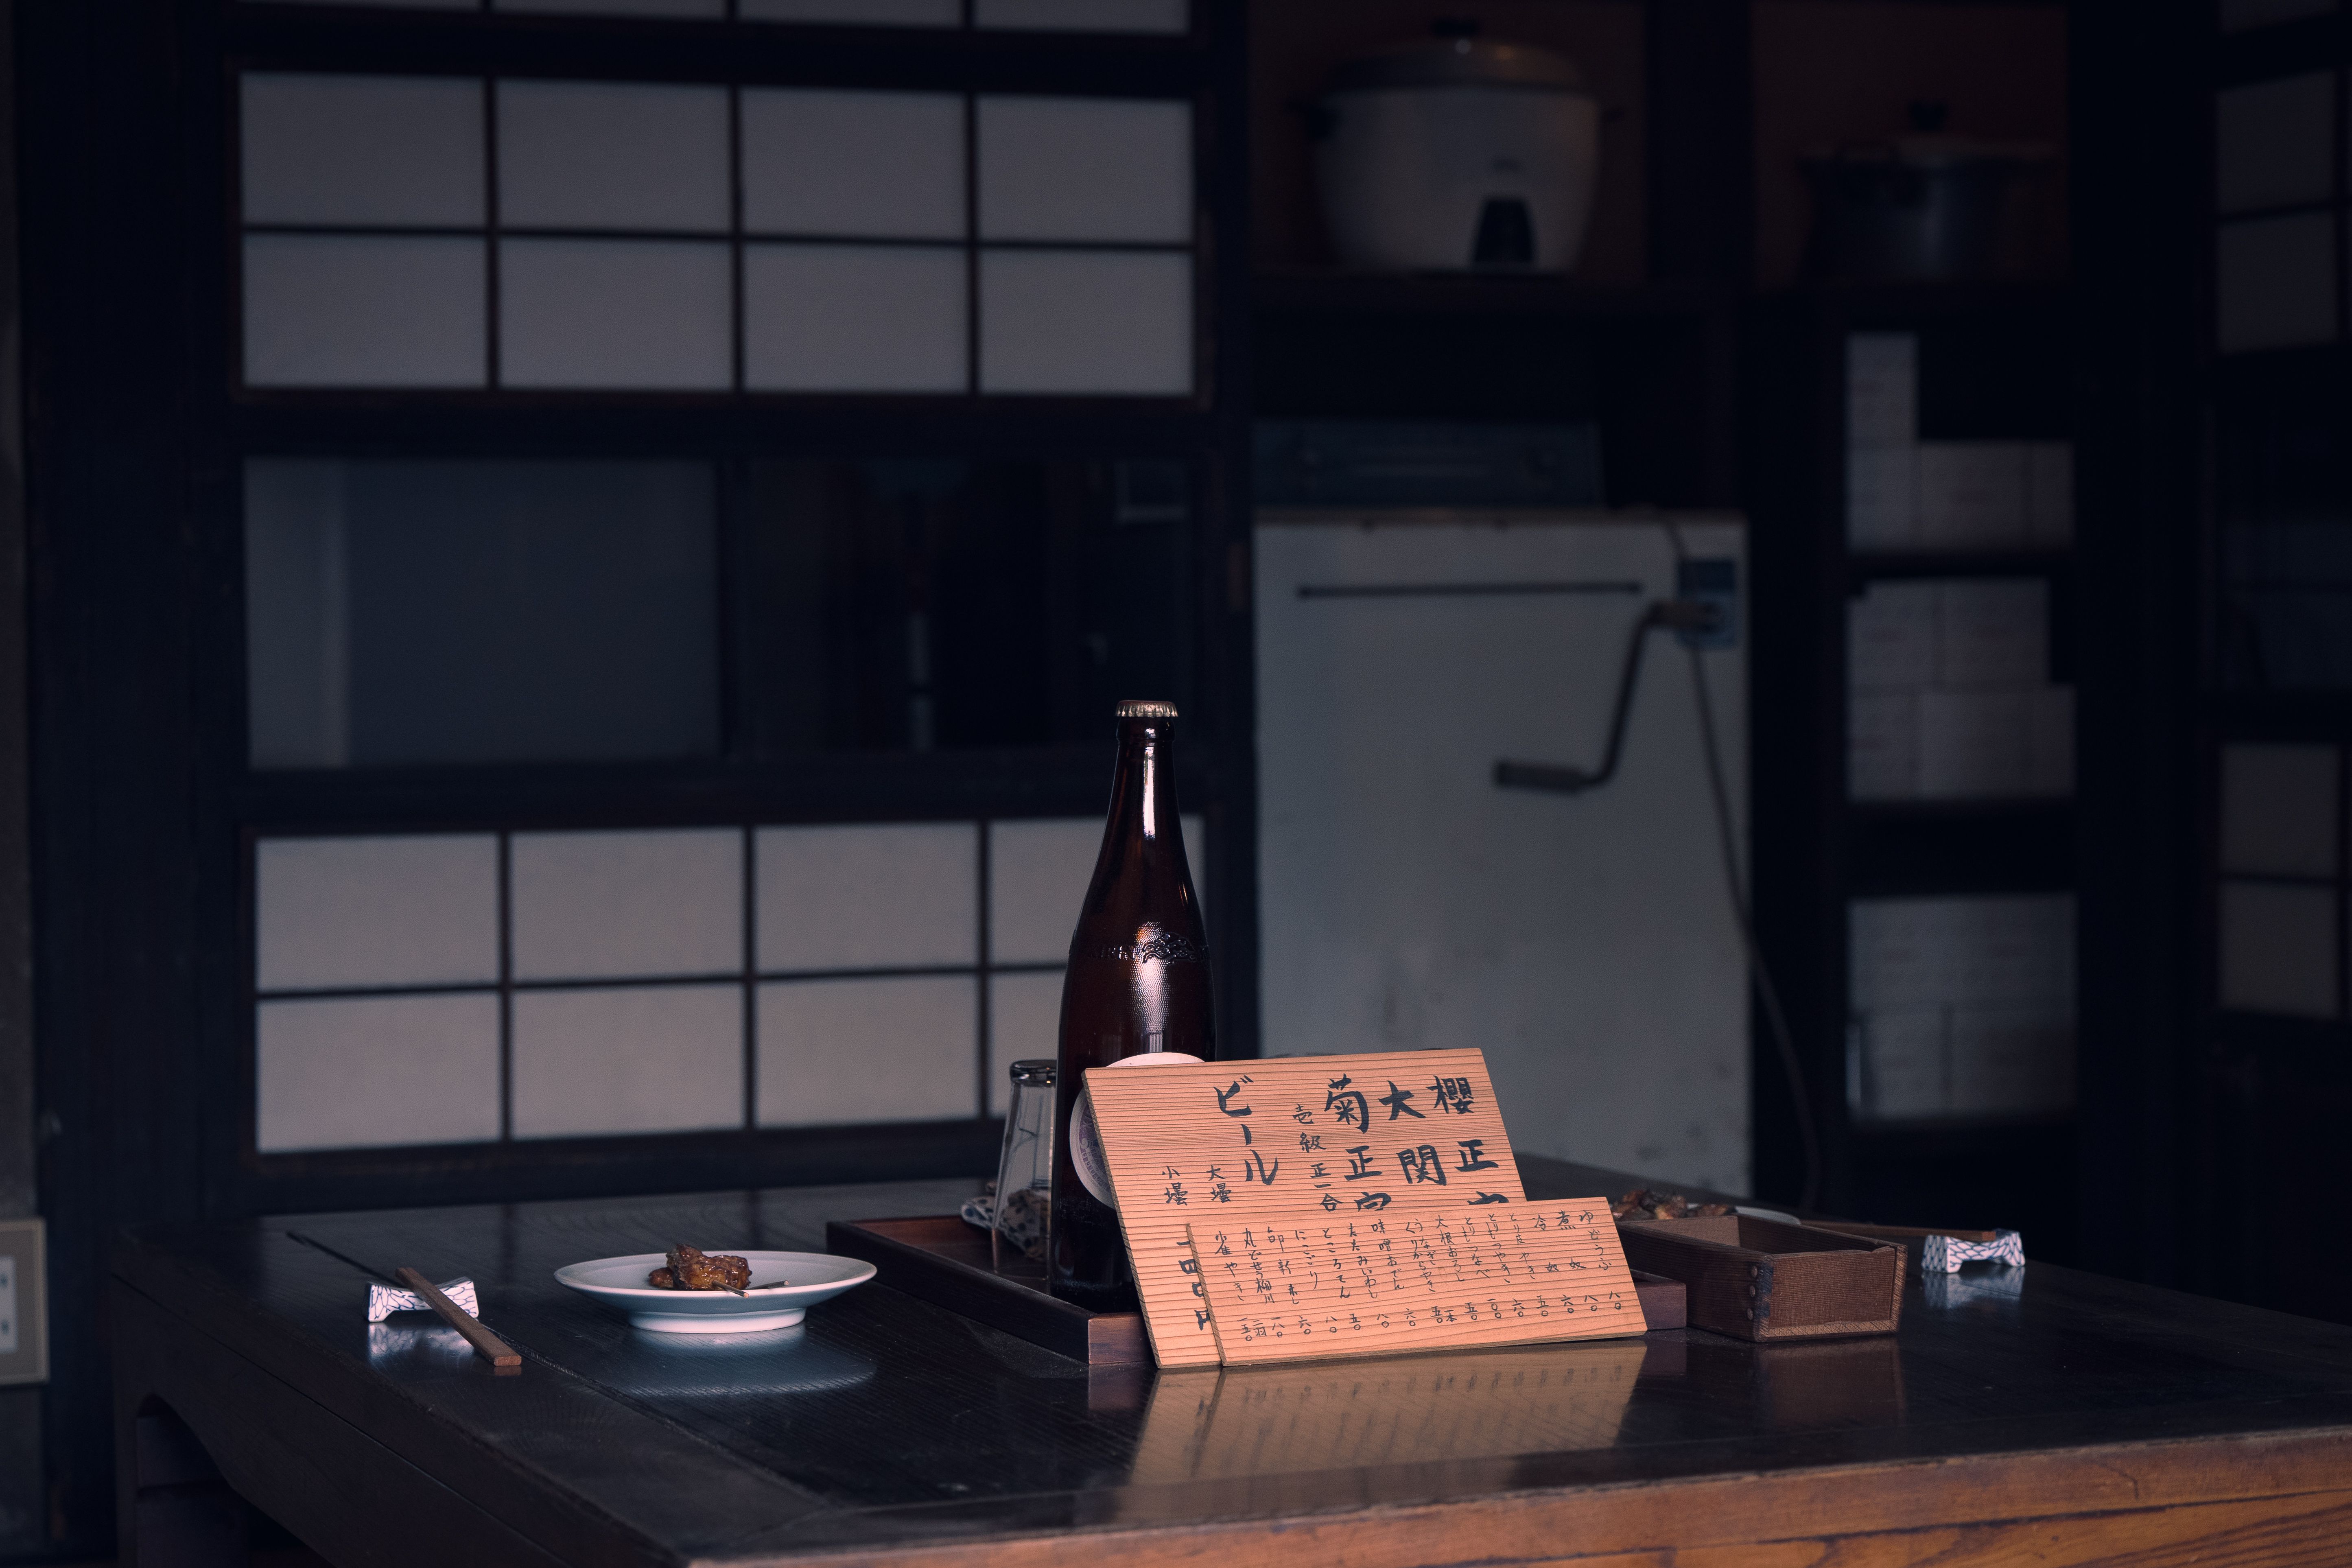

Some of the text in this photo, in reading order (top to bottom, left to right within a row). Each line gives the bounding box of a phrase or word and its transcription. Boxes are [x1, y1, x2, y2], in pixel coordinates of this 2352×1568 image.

[1213, 1075, 1279, 1185] ビール
[1378, 1080, 1447, 1186] 大関
[1323, 1228, 1350, 1298] ところてん
[1348, 1223, 1377, 1298] たたみいわし
[1436, 1215, 1465, 1282] 大根おろし
